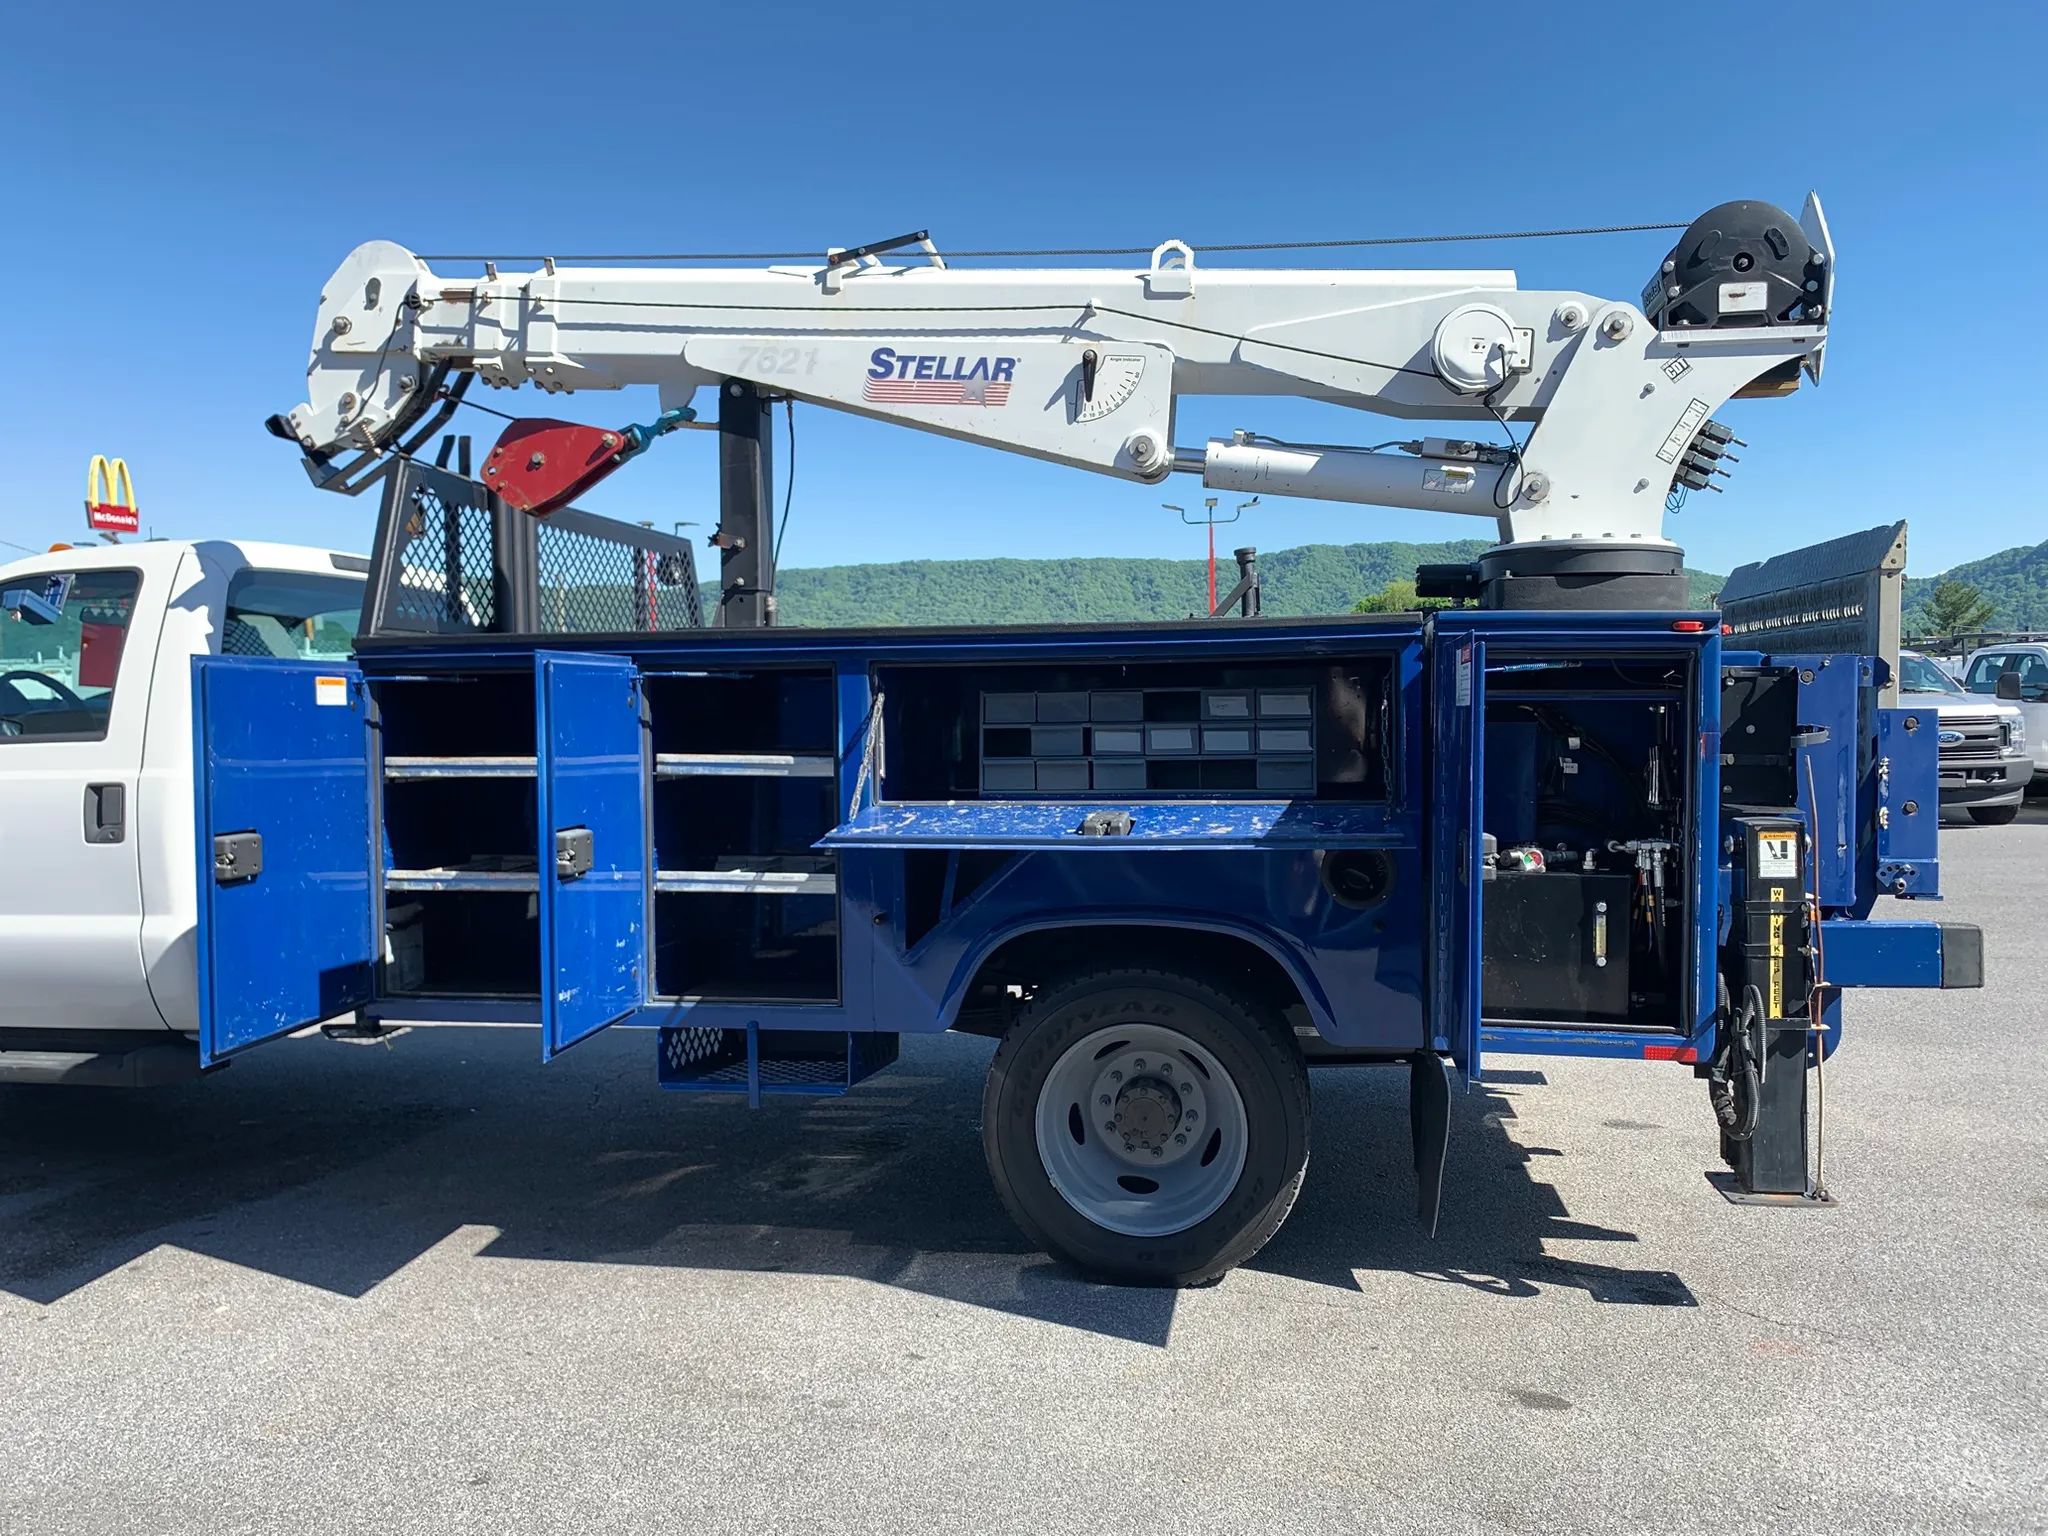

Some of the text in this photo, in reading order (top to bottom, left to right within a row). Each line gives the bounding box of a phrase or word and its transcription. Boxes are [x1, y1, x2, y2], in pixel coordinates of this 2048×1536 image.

[737, 345, 819, 375] 7621
[868, 346, 1016, 382] STELLAR
[1665, 357, 1689, 379] CDT
[93, 512, 137, 526] McDonald's
